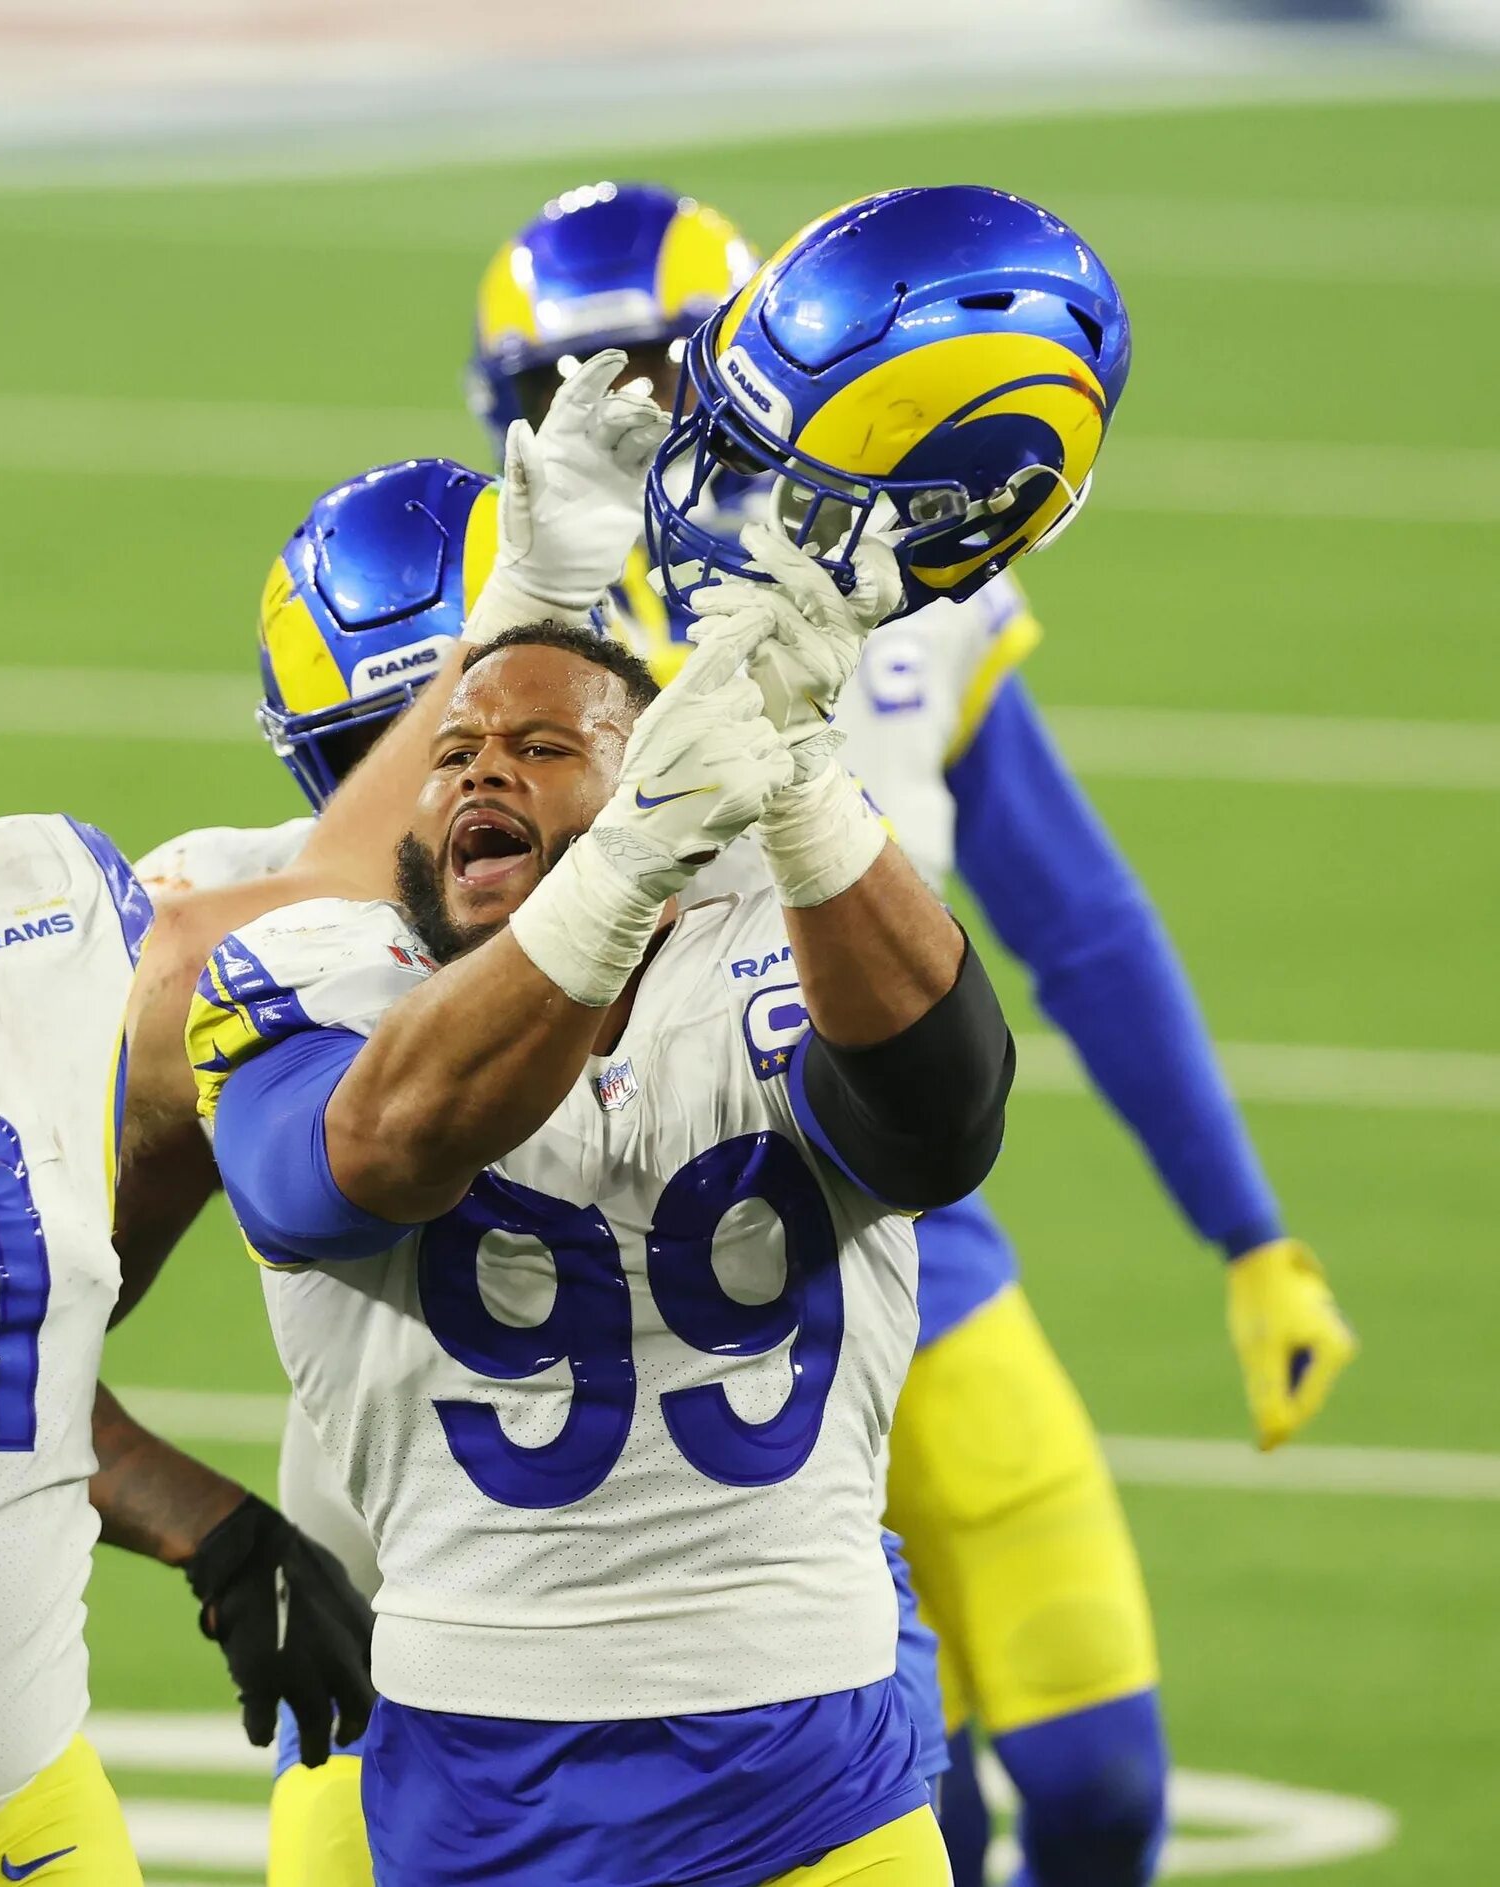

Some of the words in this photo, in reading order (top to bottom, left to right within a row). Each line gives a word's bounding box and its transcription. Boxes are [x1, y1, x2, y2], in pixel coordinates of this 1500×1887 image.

[727, 359, 773, 413] RAMS
[367, 648, 438, 680] RAMS
[730, 946, 794, 979] RA
[600, 1077, 630, 1103] NFL
[418, 1130, 845, 1509] 99
